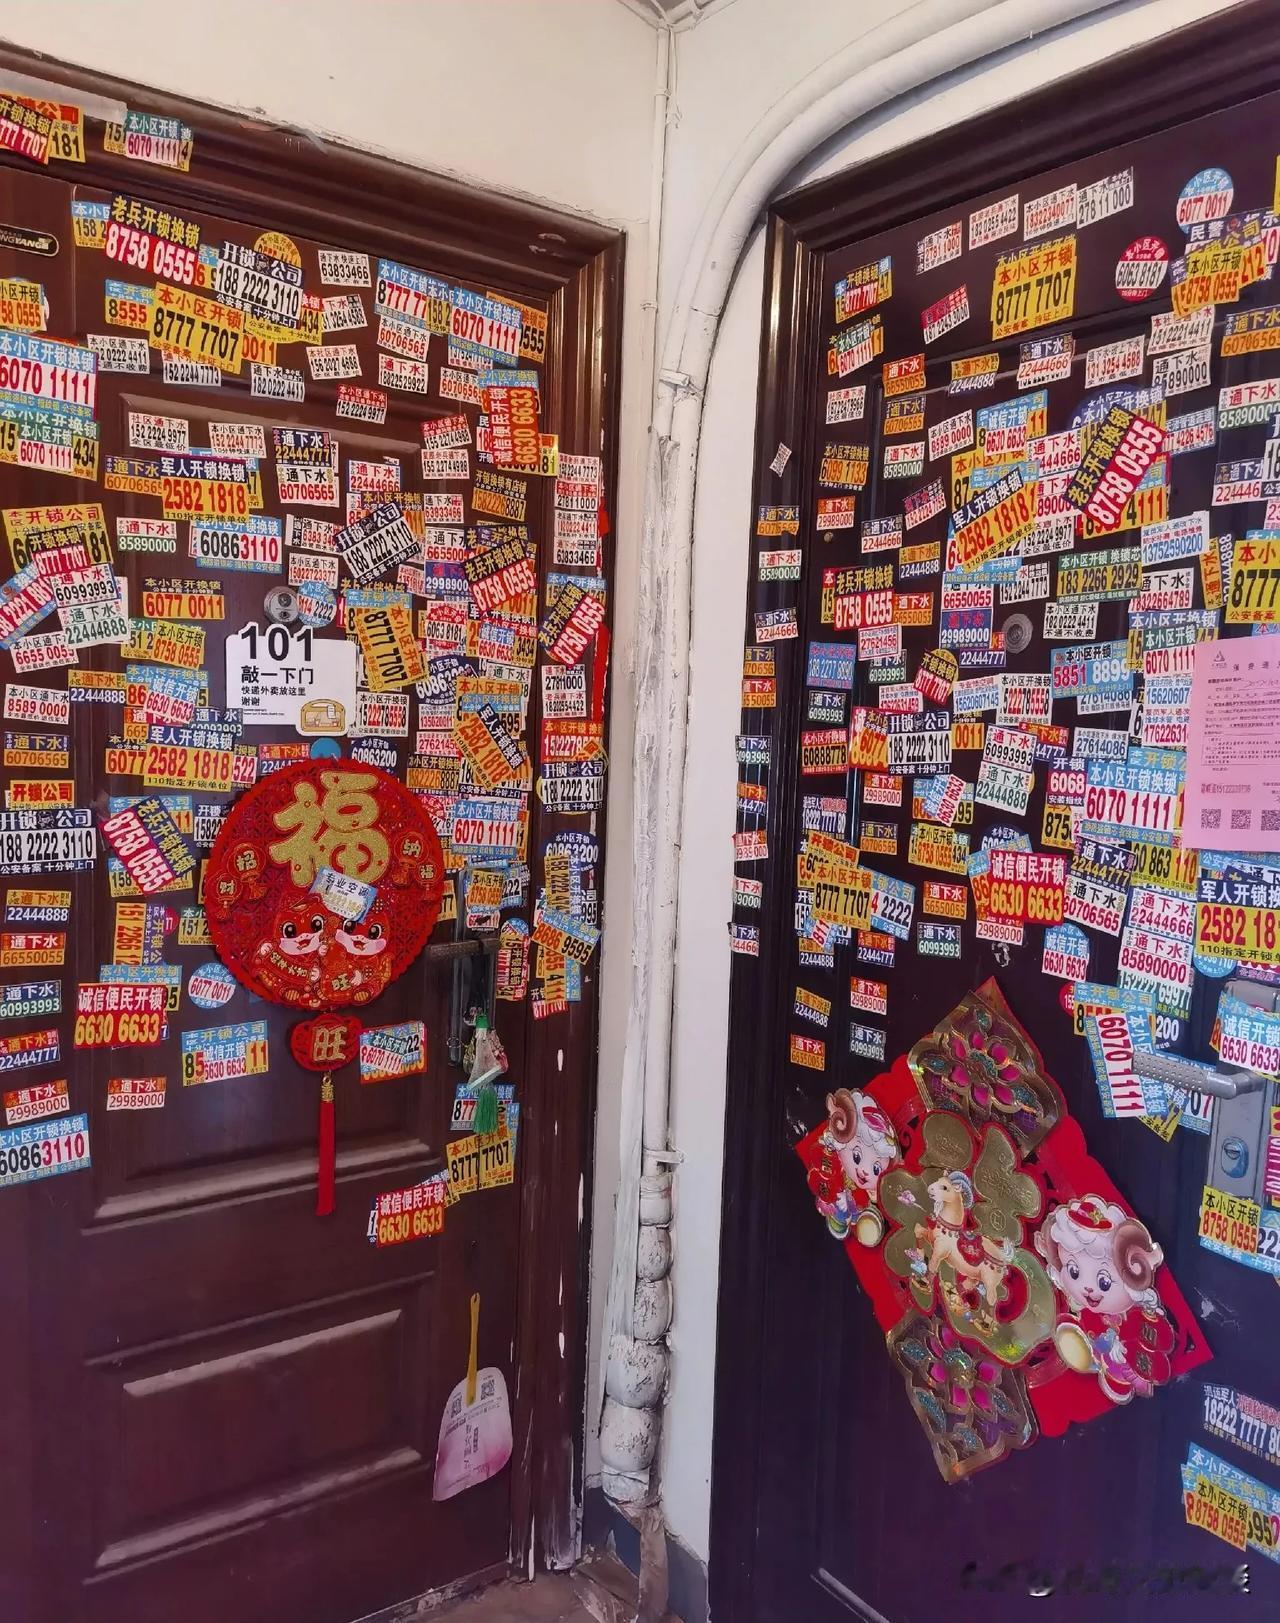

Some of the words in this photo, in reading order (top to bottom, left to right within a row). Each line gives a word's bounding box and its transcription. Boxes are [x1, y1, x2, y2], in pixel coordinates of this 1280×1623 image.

[128, 113, 178, 140] 本小区开锁
[52, 132, 80, 159] 181
[1078, 181, 1107, 203] 通下水
[1180, 199, 1202, 222] 6077
[1205, 192, 1229, 216] 0011
[111, 195, 200, 248] 老兵开锁换锁
[1191, 222, 1224, 241] 民警
[106, 224, 149, 269] 8758
[153, 242, 195, 286] 0555
[222, 241, 256, 268] 开锁
[271, 257, 302, 286] 公司
[999, 247, 1073, 286] 本小区开锁
[321, 264, 369, 280] 63833466
[218, 264, 240, 296] 188
[242, 271, 272, 308] 2222
[271, 282, 299, 318] 3110
[996, 285, 1031, 325] 8777
[1036, 269, 1072, 305] 7707
[159, 286, 242, 329] 本小区开锁
[455, 289, 521, 328] 本小区开锁换锁
[153, 308, 195, 342] 8777
[200, 321, 239, 361] 7707
[452, 308, 484, 342] 6070
[488, 320, 518, 355] 1111
[838, 325, 871, 352] 本小区开锁
[1031, 339, 1063, 359] 通下水
[384, 358, 420, 376] 通下水
[889, 358, 920, 378] 通下水
[885, 375, 925, 393] 66550055
[950, 371, 995, 393] 22444888
[1228, 387, 1276, 407] 通下水
[20, 442, 44, 464] 6070
[49, 446, 72, 469] 1111
[889, 446, 921, 461] 通下水
[1068, 407, 1132, 504] 老兵开锁换锁
[114, 459, 159, 478] 通下水
[161, 458, 246, 482] 军人开锁换锁
[356, 466, 394, 478] 通下水
[883, 461, 922, 479] 85890000
[1086, 473, 1132, 525] 8758
[1116, 422, 1163, 475] 0555
[162, 480, 203, 511] 2582
[209, 483, 246, 514] 1818
[280, 484, 334, 500] 60706565
[350, 479, 400, 492] 22444666
[952, 467, 1023, 530] 军人开锁换锁
[26, 508, 100, 522] 开锁公司
[426, 507, 460, 518] 63833466
[30, 528, 80, 550] 开锁换锁
[126, 522, 170, 536] 通下水
[871, 518, 895, 535] 通下水
[350, 551, 369, 574] 188
[369, 536, 393, 565] 2222
[389, 524, 413, 550] 3110
[466, 539, 524, 580] 老兵开锁换锁
[765, 552, 797, 565] 通下水
[836, 564, 894, 595] 老兵开锁换锁
[900, 560, 940, 578] 22444888
[1060, 571, 1078, 593] 183
[1083, 568, 1108, 591] 2266
[1111, 564, 1138, 587] 2929
[1205, 547, 1221, 598] 通下水
[56, 579, 114, 601] 60993993
[472, 579, 500, 611] 8758
[502, 560, 532, 593] 0555
[70, 602, 116, 622] 通下水
[146, 592, 185, 617] 6077
[189, 596, 222, 618] 0011
[836, 595, 863, 629] 8758
[865, 592, 893, 622] 0555
[943, 591, 992, 608] 66550055
[538, 582, 582, 645] 老兵开锁换锁
[1230, 610, 1274, 621] 公安备案
[241, 625, 311, 661] 101
[390, 605, 422, 678] 本小区开锁
[553, 622, 586, 664] 8758
[579, 600, 604, 633] 0555
[241, 665, 313, 684] 敲一下门
[1053, 663, 1087, 687] 5851
[1092, 659, 1128, 682] 8899
[70, 688, 125, 702] 22444888
[241, 686, 306, 696] 快递外卖放这里
[241, 697, 260, 706] 谢谢
[891, 713, 914, 732] 开锁
[924, 711, 950, 730] 公司
[14, 736, 62, 750] 通下水
[151, 726, 232, 749] 军人开锁换锁
[479, 706, 524, 768] 军人开锁换锁
[889, 736, 903, 763] 188
[906, 734, 927, 763] 2222
[928, 733, 950, 762] 3110
[148, 746, 186, 775] 2582
[193, 748, 230, 778] 1818
[984, 742, 1032, 766] 60993993
[986, 766, 1024, 787] 通下水
[1050, 774, 1084, 794] 6068
[1090, 766, 1177, 793] 本小区开锁换锁
[13, 784, 71, 801] 开锁公司
[976, 781, 1028, 810] 22444888
[459, 804, 517, 820] 本小区开锁换锁
[1086, 792, 1126, 823] 6070
[1131, 797, 1170, 830] 1111
[137, 799, 196, 876] 老兵开锁换锁
[269, 771, 391, 887] 福
[455, 823, 483, 844] 6070
[488, 824, 514, 846] 1111
[27, 832, 58, 860] 2222
[62, 830, 92, 858] 3110
[991, 852, 1065, 885] 诚信便民开锁
[816, 883, 840, 908] 8777
[843, 889, 870, 919] 7707
[929, 884, 962, 900] 通下水
[990, 881, 1024, 916] 6630
[1028, 885, 1062, 922] 6633
[1140, 892, 1189, 917] 通下水
[7, 907, 68, 921] 22444888
[882, 896, 913, 927] 2222
[1131, 907, 1193, 936] 22444666
[1200, 904, 1246, 945] 2582
[10, 935, 58, 949] 通下水
[923, 925, 955, 942] 通下水
[919, 941, 960, 957] 60993993
[1121, 948, 1187, 985] 85890000
[6, 984, 54, 1000] 通下水
[79, 988, 164, 1012] 诚信便民开锁
[851, 995, 886, 1014] 29989000
[76, 1015, 113, 1045] 6630
[118, 1013, 160, 1043] 6633
[795, 1003, 828, 1028] 22444888
[314, 1026, 346, 1062] 旺
[1097, 1016, 1132, 1062] 6070
[1221, 1036, 1248, 1064] 6630
[1250, 1041, 1279, 1072] 6633
[204, 1058, 223, 1080] 6630
[226, 1058, 246, 1076] 6633
[121, 1078, 156, 1092] 通下水
[1109, 1067, 1145, 1112] 1111
[109, 1093, 163, 1108] 29989000
[451, 1153, 480, 1183] 8777
[482, 1144, 509, 1167] 7707
[380, 1183, 444, 1214] 诚信便民开锁
[1205, 1191, 1258, 1226] 本小区开锁
[380, 1216, 408, 1243] 6630
[413, 1211, 442, 1236] 6633
[1202, 1210, 1229, 1241] 8758
[1230, 1222, 1257, 1251] 0555
[1205, 1399, 1237, 1438] 18222
[1240, 1413, 1268, 1444] 7777
[1198, 1480, 1249, 1522] 本小区开锁
